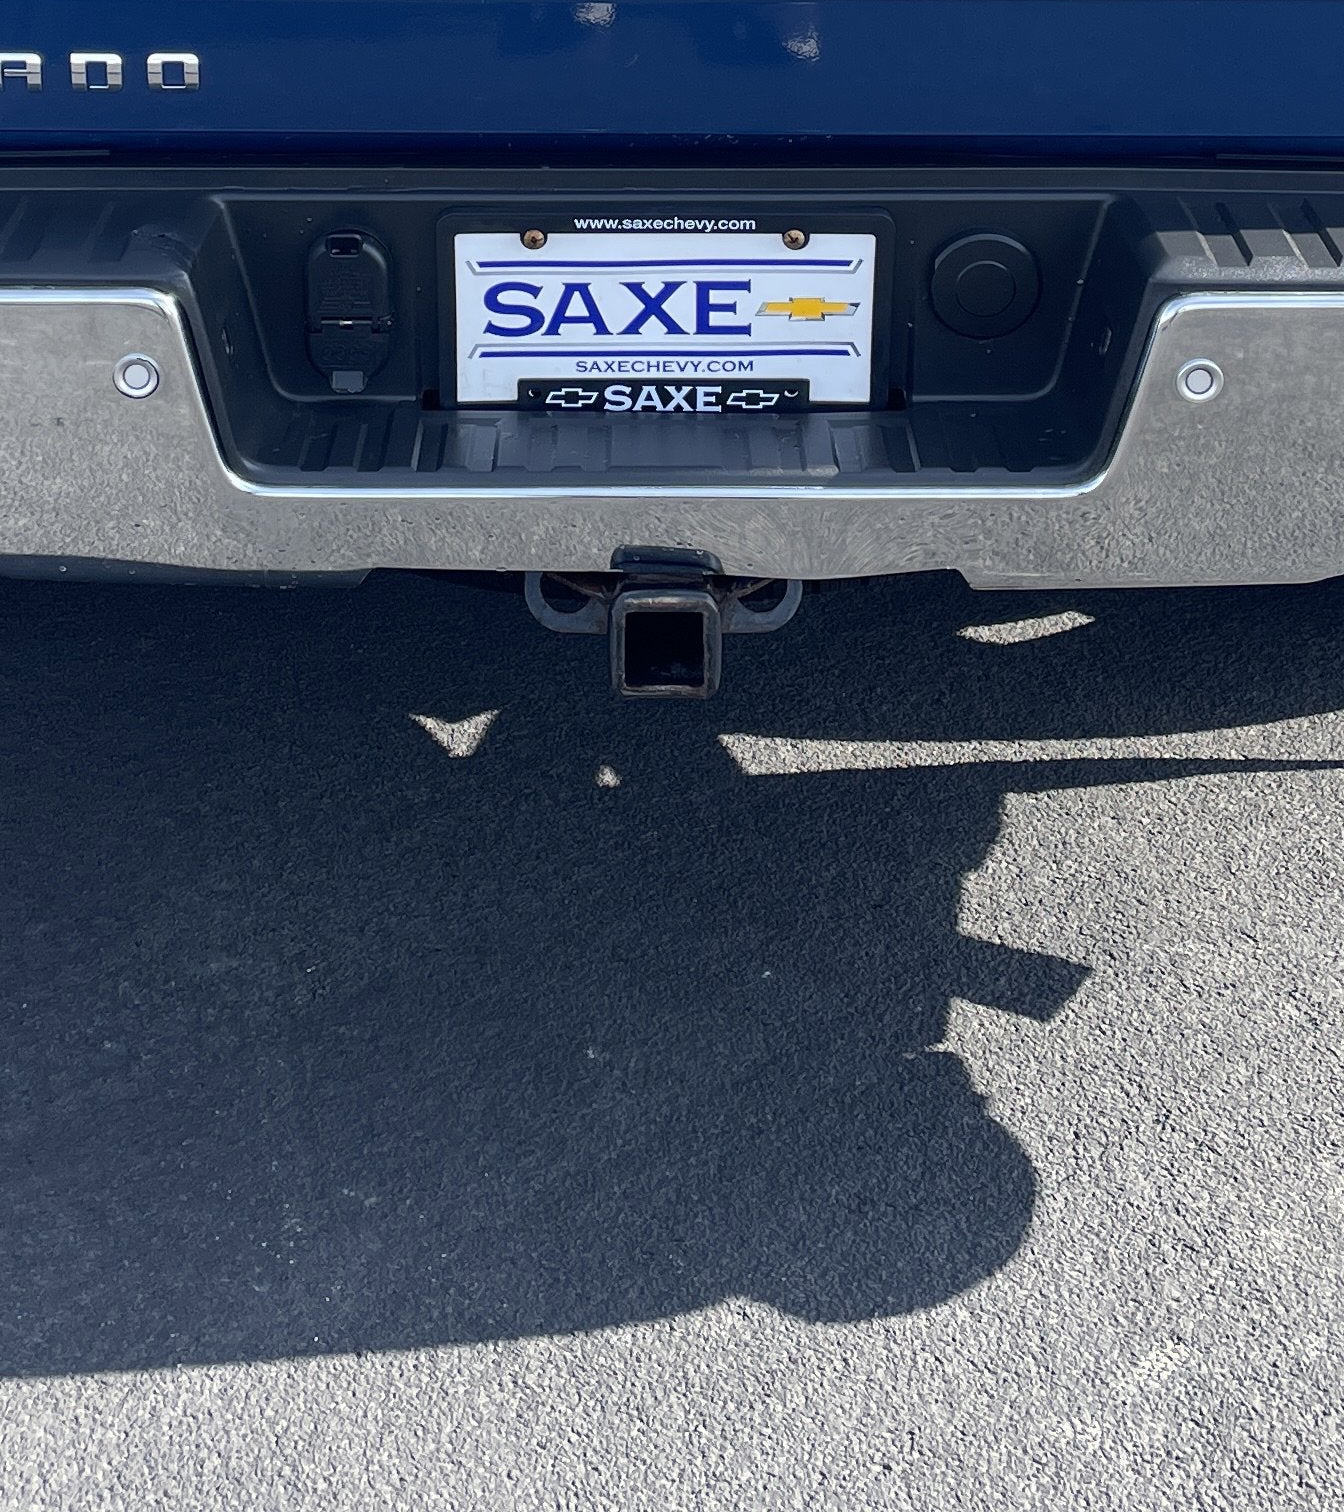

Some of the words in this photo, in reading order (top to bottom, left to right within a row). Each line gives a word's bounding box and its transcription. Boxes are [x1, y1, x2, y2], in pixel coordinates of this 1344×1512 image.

[573, 216, 757, 233] www.saxechevy.com
[482, 279, 753, 338] SAXE
[575, 360, 755, 374] SAXECHEVY.COM
[603, 384, 723, 413] SAXE
